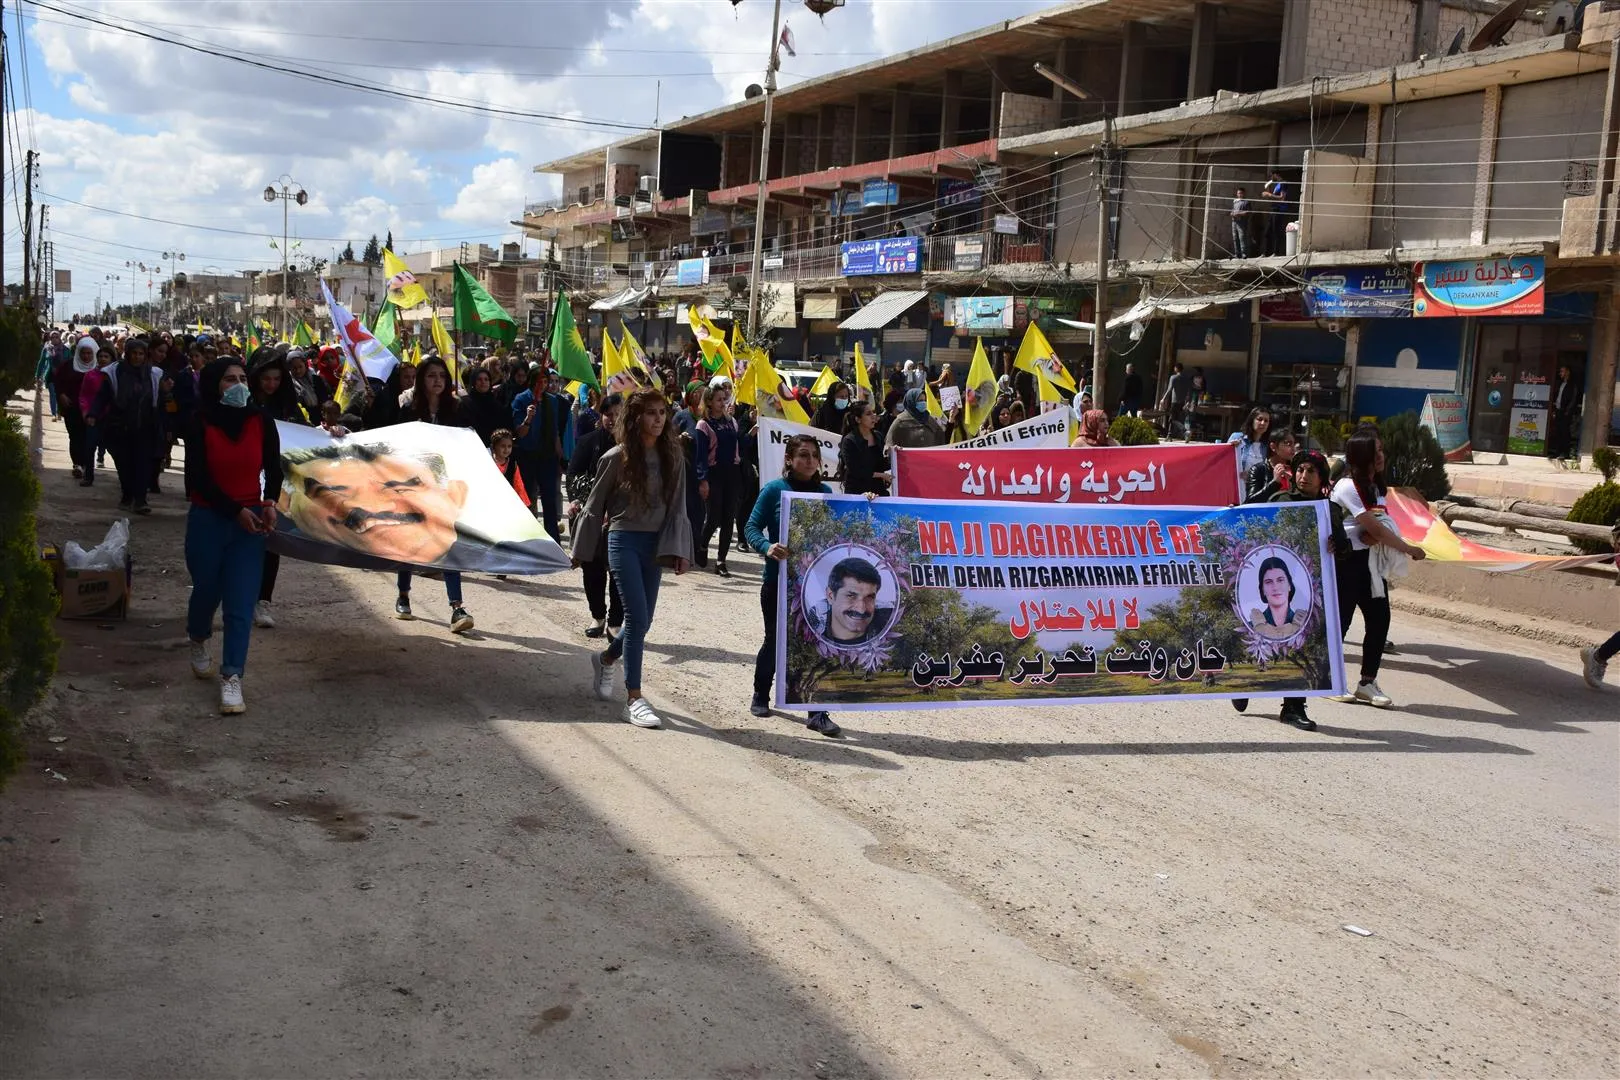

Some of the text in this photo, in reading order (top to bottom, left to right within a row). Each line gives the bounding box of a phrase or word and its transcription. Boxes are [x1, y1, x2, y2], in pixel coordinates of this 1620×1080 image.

[1361, 275, 1377, 290] نت
[1379, 278, 1408, 293] سبيد
[1386, 267, 1409, 278] شركة
[1474, 260, 1535, 286] صيدلية
[1453, 290, 1500, 299] DERMANXANE
[1002, 430, 1014, 443] li
[1018, 420, 1065, 440] Efrînê
[958, 460, 1167, 504] الحرية والعدالة
[918, 519, 1206, 558] NA JI DAGIRKERIYÊ RE
[910, 559, 1225, 589] DEM DEMA RIZGARKIRINA EFRÎNÊ YE
[1009, 596, 1141, 640] لا للاحتلال
[912, 638, 1227, 687] حان وقت تحرير عفرين
